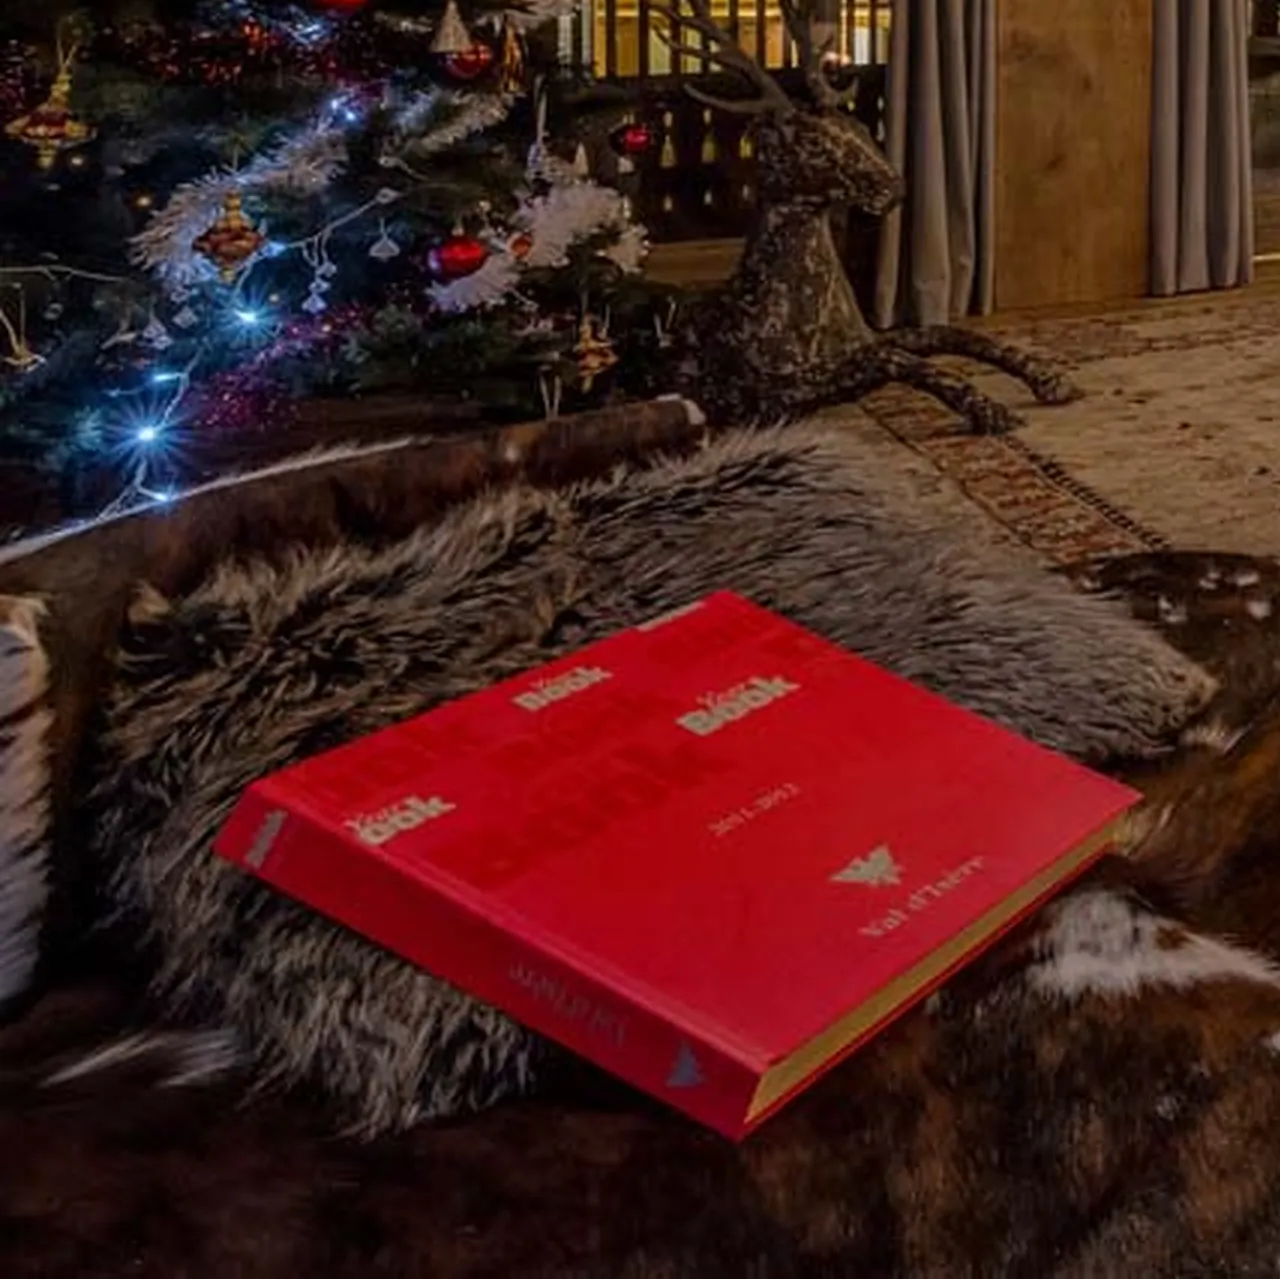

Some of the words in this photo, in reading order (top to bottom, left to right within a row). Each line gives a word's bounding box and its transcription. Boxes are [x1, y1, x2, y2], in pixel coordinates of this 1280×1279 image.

[674, 675, 802, 736] Book
[357, 794, 457, 845] ook
[856, 906, 909, 938] Val
